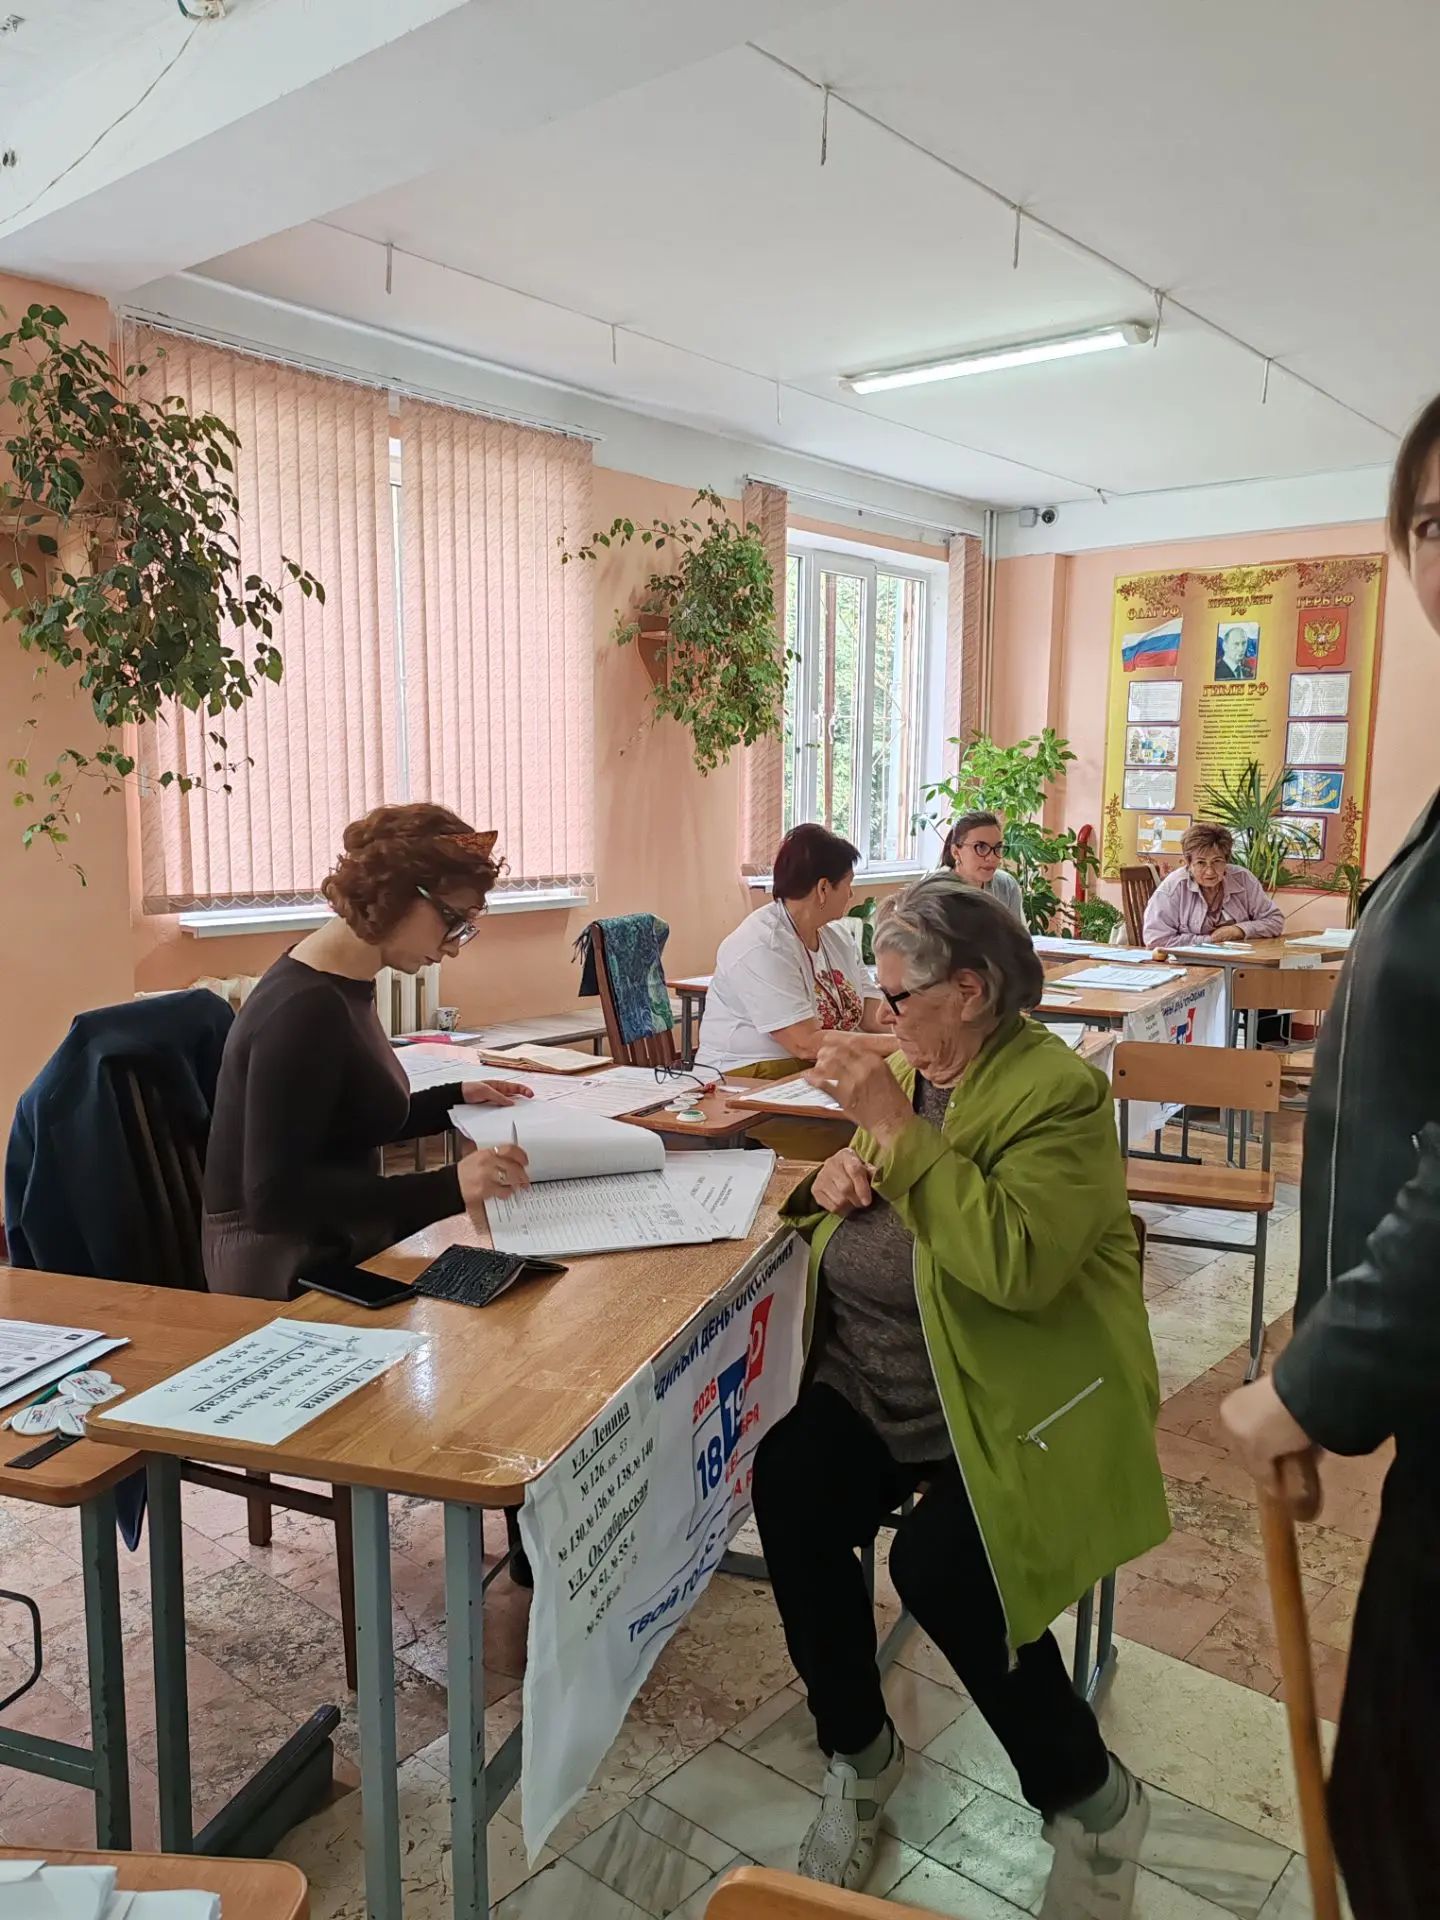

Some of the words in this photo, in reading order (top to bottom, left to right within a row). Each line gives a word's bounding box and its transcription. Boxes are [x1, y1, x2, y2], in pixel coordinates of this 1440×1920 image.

[1127, 607, 1159, 620] ФЛАГ
[1161, 604, 1181, 617] РФ
[1296, 596, 1331, 609] ГЕРБ
[1333, 592, 1355, 607] РФ
[1202, 685, 1245, 697] ГИМН
[1247, 681, 1269, 697] РФ
[701, 1304, 731, 1355] ДЕНЬ
[194, 1352, 305, 1412] Октябрьская
[300, 1372, 364, 1409] Ленина
[692, 1377, 717, 1425] 2026
[213, 1410, 243, 1424] 140
[572, 1447, 589, 1471] ул.
[590, 1401, 631, 1454] Ленина
[696, 1435, 723, 1501] 18
[724, 1378, 746, 1439] 19
[588, 1478, 650, 1568] Октябрьская
[628, 1585, 680, 1643] ТВОЙ
